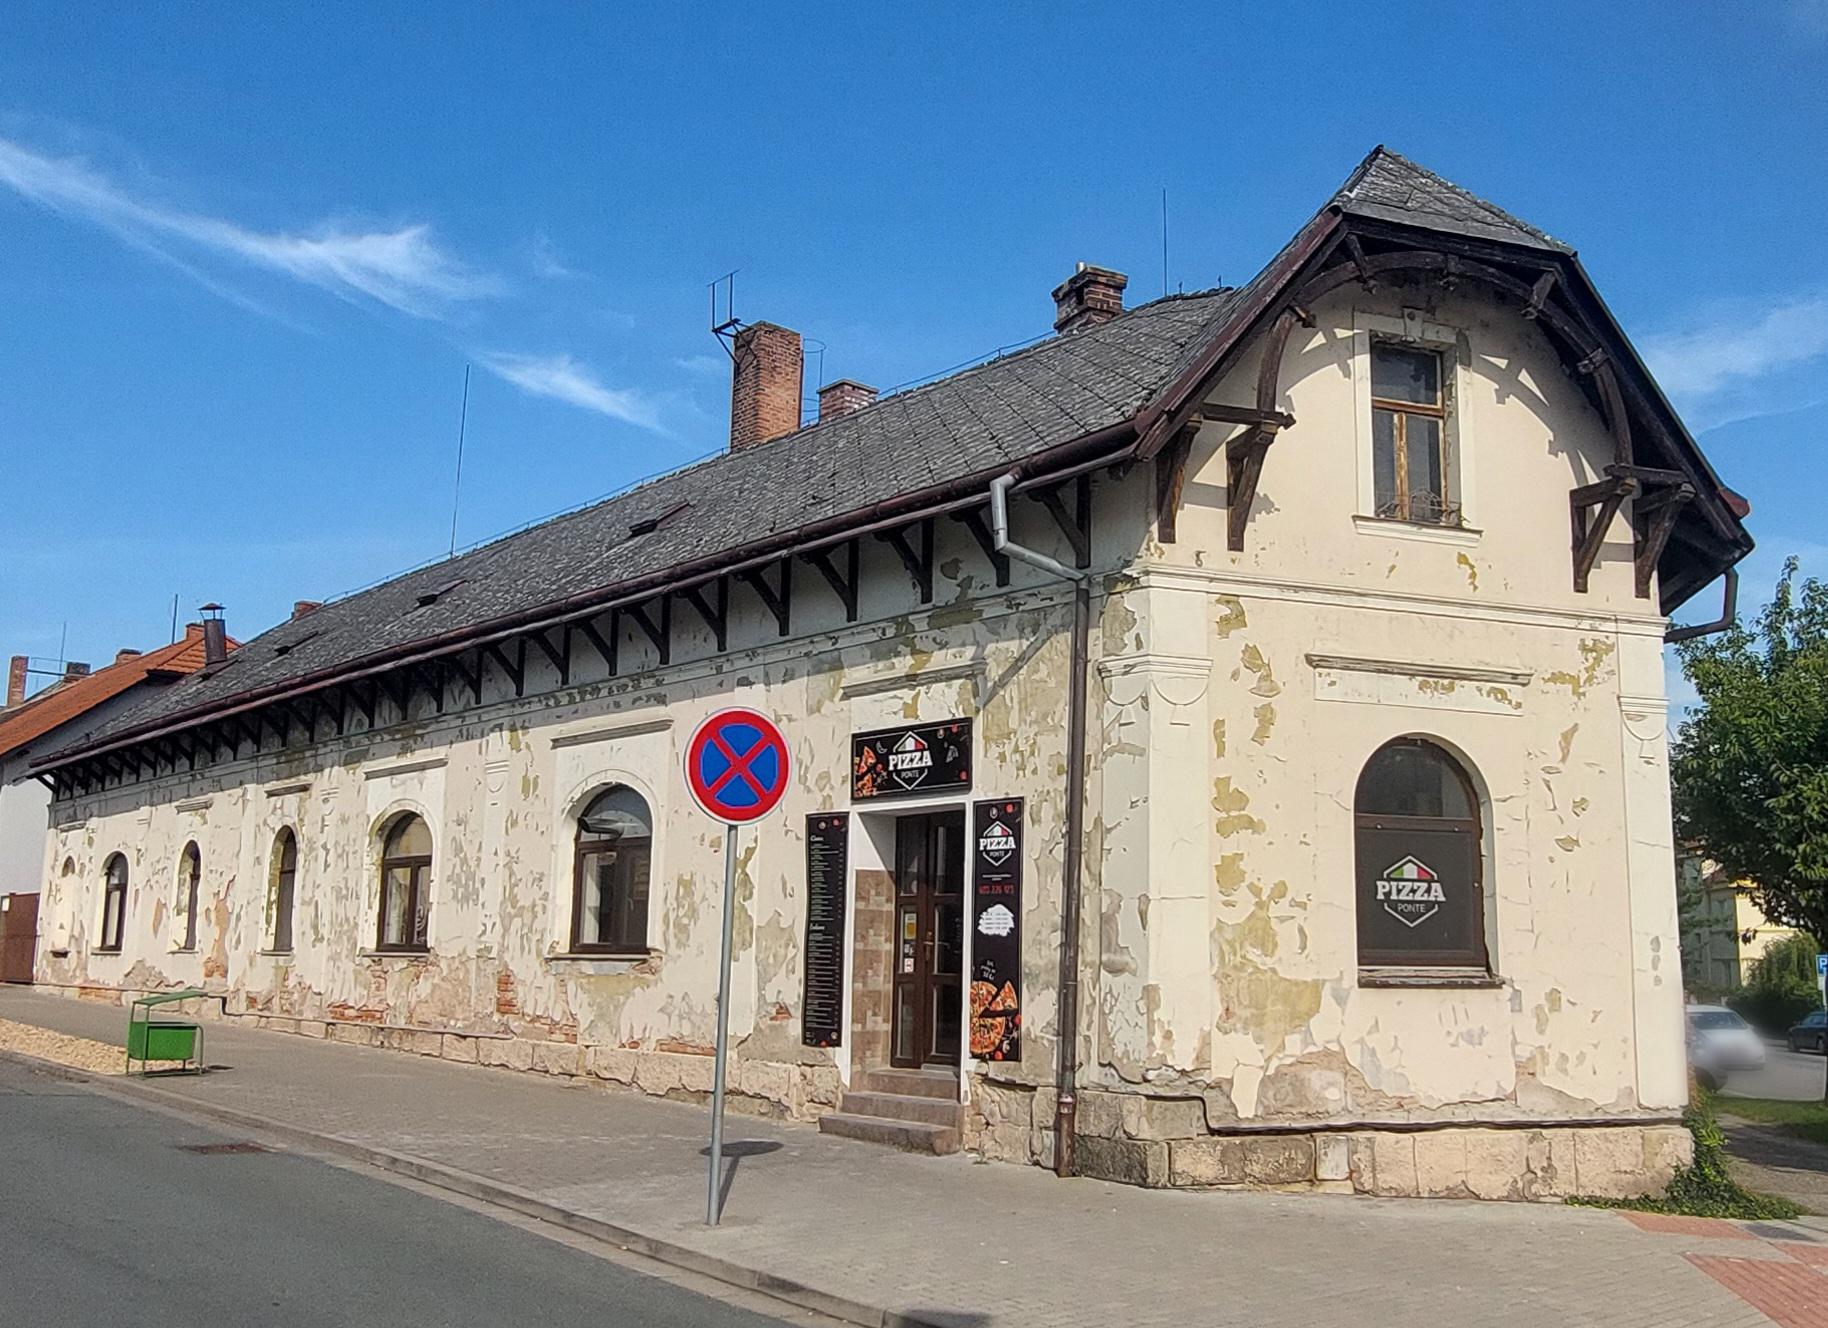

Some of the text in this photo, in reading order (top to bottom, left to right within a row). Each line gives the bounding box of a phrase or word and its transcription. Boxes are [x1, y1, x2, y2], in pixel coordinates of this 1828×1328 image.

[888, 751, 933, 770] PIZZA
[901, 770, 920, 779] PONTE
[979, 836, 1016, 851] PIZZA
[1376, 881, 1446, 901] PIZZA
[1397, 903, 1426, 913] PONTE
[1819, 957, 1828, 969] P
